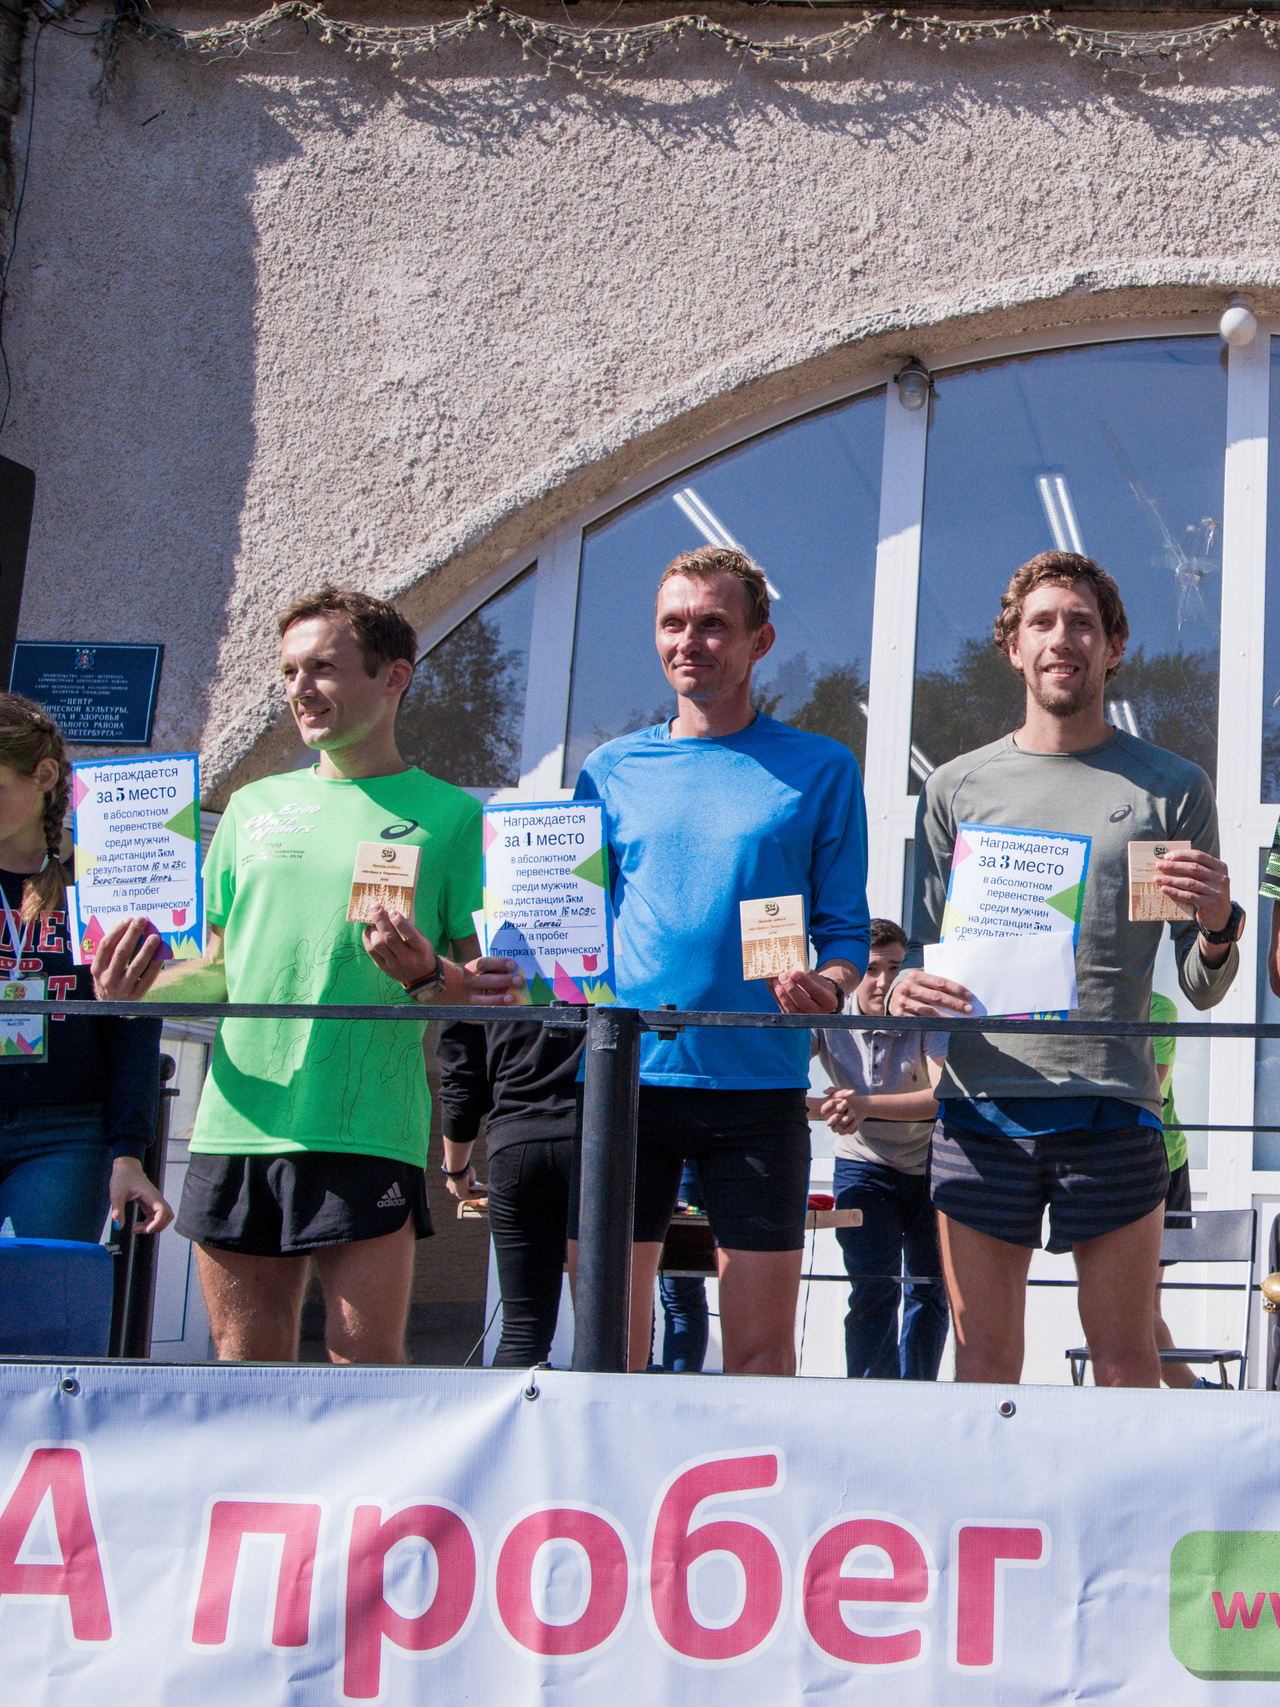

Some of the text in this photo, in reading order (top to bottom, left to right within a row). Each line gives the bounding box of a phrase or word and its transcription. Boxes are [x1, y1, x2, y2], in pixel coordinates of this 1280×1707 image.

[95, 768, 178, 783] Награждается
[97, 791, 113, 803] за
[129, 786, 176, 800] место
[110, 808, 168, 819] абсолютном
[110, 822, 163, 833] первенстве
[504, 814, 585, 828] Награждается
[105, 836, 169, 849] среди мужчин
[505, 835, 520, 847] за
[537, 833, 584, 846] место
[980, 837, 1069, 856] Награждается
[97, 854, 107, 862] на
[109, 851, 156, 862] дистанции
[518, 854, 576, 864] абсолютном
[93, 863, 149, 876] результатом
[979, 854, 1064, 876] за 3 место
[516, 867, 571, 878] первенстве
[512, 882, 578, 893] среди мужчин
[983, 876, 1052, 891] в абсолютном
[129, 886, 159, 897] пробег
[987, 889, 1044, 903] первенстве
[515, 896, 564, 906] дистанции
[500, 909, 556, 920] результатом
[980, 903, 1049, 918] среди мужчин
[968, 915, 979, 923] на
[981, 917, 1032, 930] дистанции
[536, 931, 568, 942] пробег
[961, 926, 1022, 938] результато
[377, 1197, 406, 1208] adidas
[190, 1452, 1043, 1700] пробег
